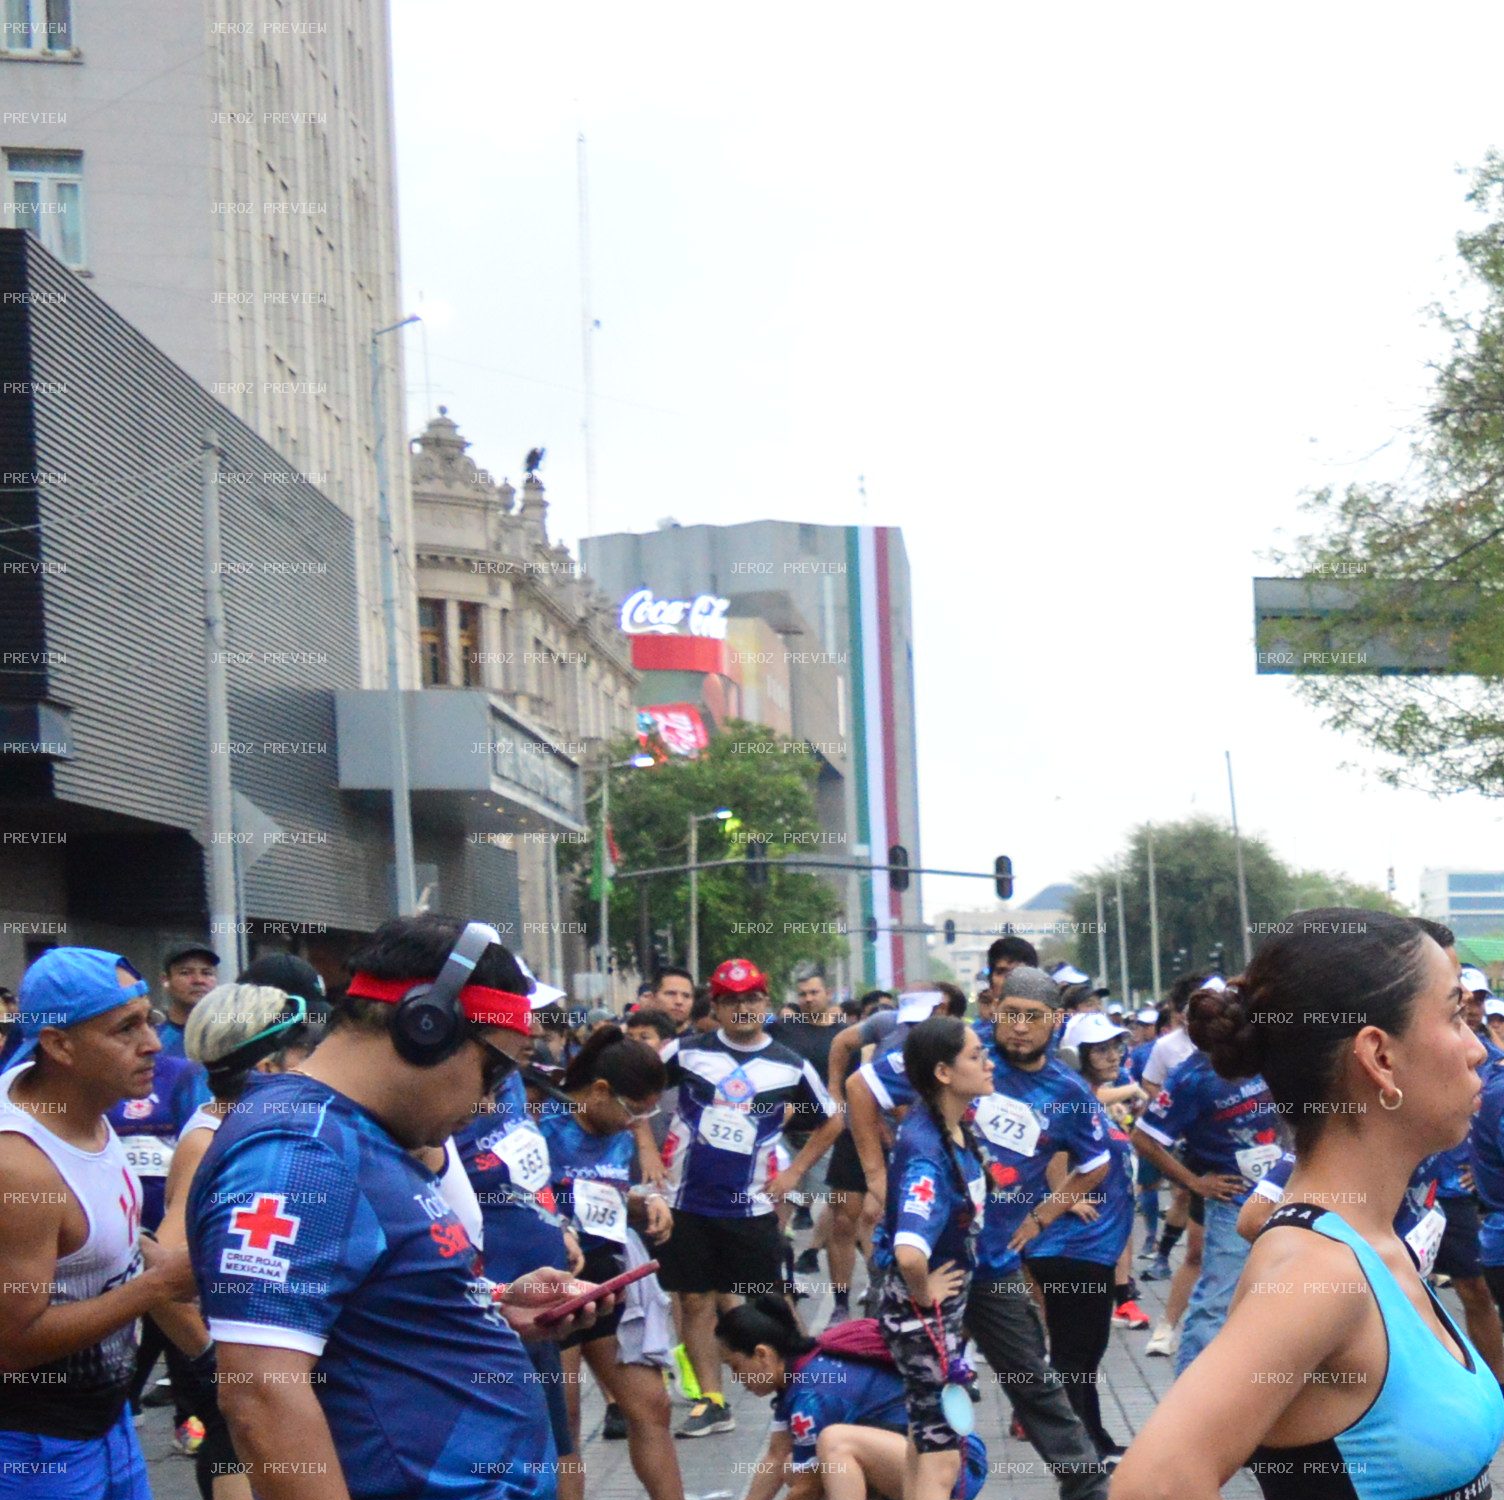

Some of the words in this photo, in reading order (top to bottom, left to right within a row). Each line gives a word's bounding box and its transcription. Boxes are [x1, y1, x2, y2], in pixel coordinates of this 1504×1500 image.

[710, 1124, 744, 1143] 326
[989, 1115, 1026, 1140] 473
[517, 1147, 545, 1180] 363
[226, 1252, 254, 1263] CRUZ
[256, 1255, 284, 1268] ROJA
[224, 1262, 281, 1278] MEXICANA
